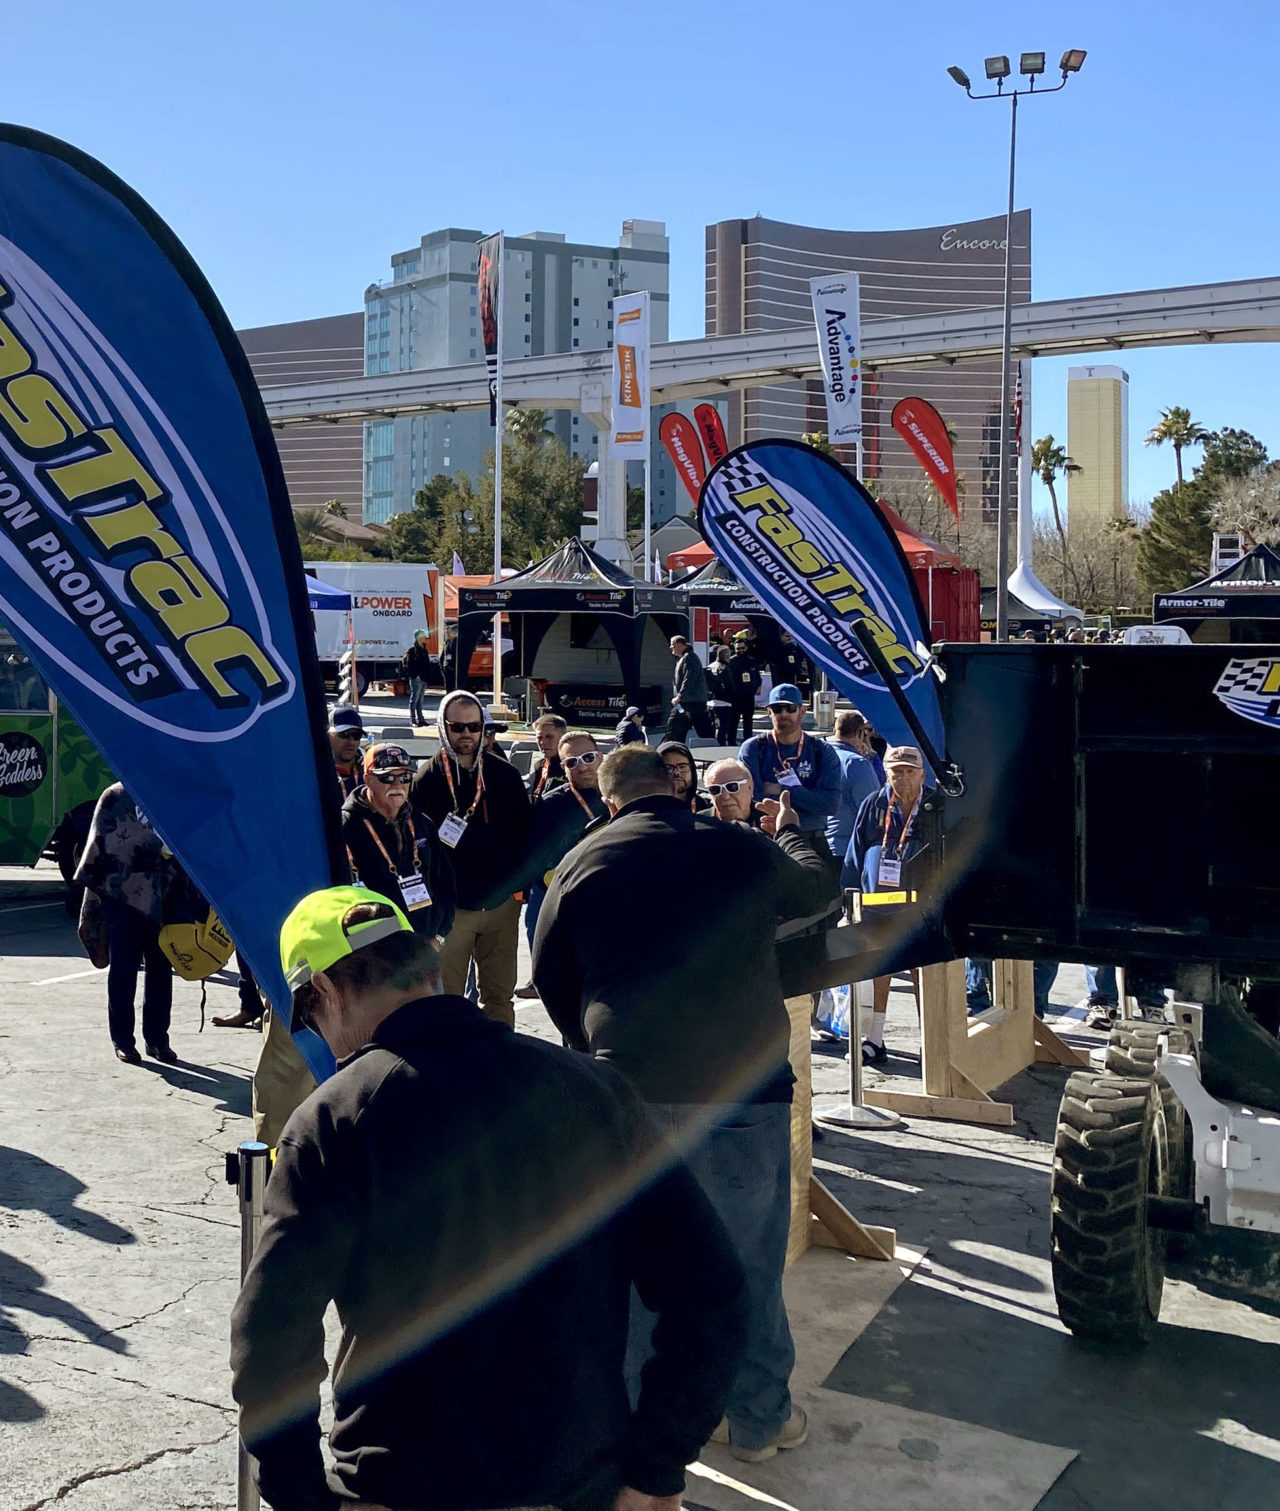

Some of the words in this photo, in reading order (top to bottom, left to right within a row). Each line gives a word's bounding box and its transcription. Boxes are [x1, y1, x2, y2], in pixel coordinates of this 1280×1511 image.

[940, 228, 1028, 251] Encore
[624, 350, 633, 403] KINESIK
[825, 308, 847, 403] Advantage
[671, 437, 700, 487] MagVibe
[908, 422, 949, 474] SUPERIOR
[29, 531, 160, 687] PRODUCTS
[682, 583, 738, 591] Advantage
[725, 519, 812, 605] CONSTRUCTION
[806, 608, 870, 671] PRODUCTS
[730, 600, 765, 610] Advantag
[1159, 599, 1226, 607] Armor-Tile
[574, 697, 605, 706] Access
[608, 697, 625, 707] Tile
